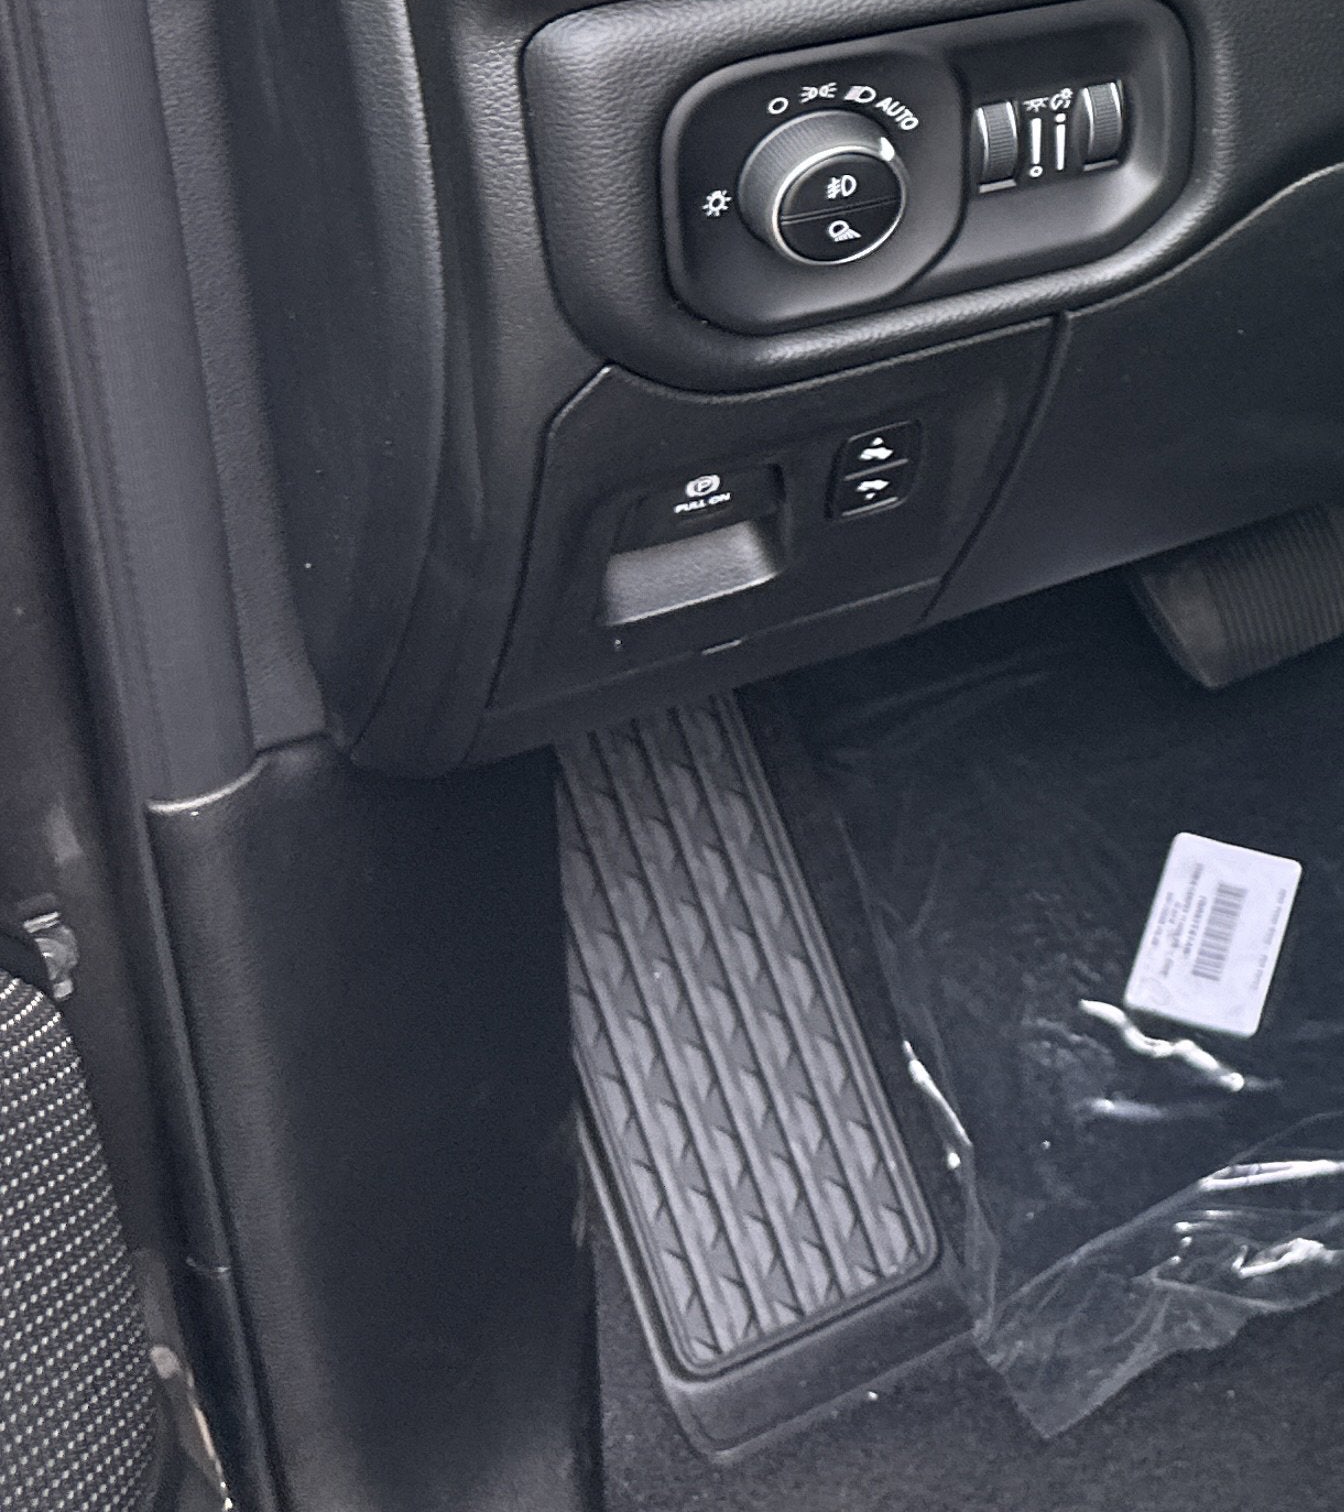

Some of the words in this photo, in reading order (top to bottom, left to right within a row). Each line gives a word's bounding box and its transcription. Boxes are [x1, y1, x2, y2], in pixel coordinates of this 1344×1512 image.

[875, 97, 919, 131] AUTO
[674, 499, 707, 514] PULL
[708, 492, 731, 505] ON
